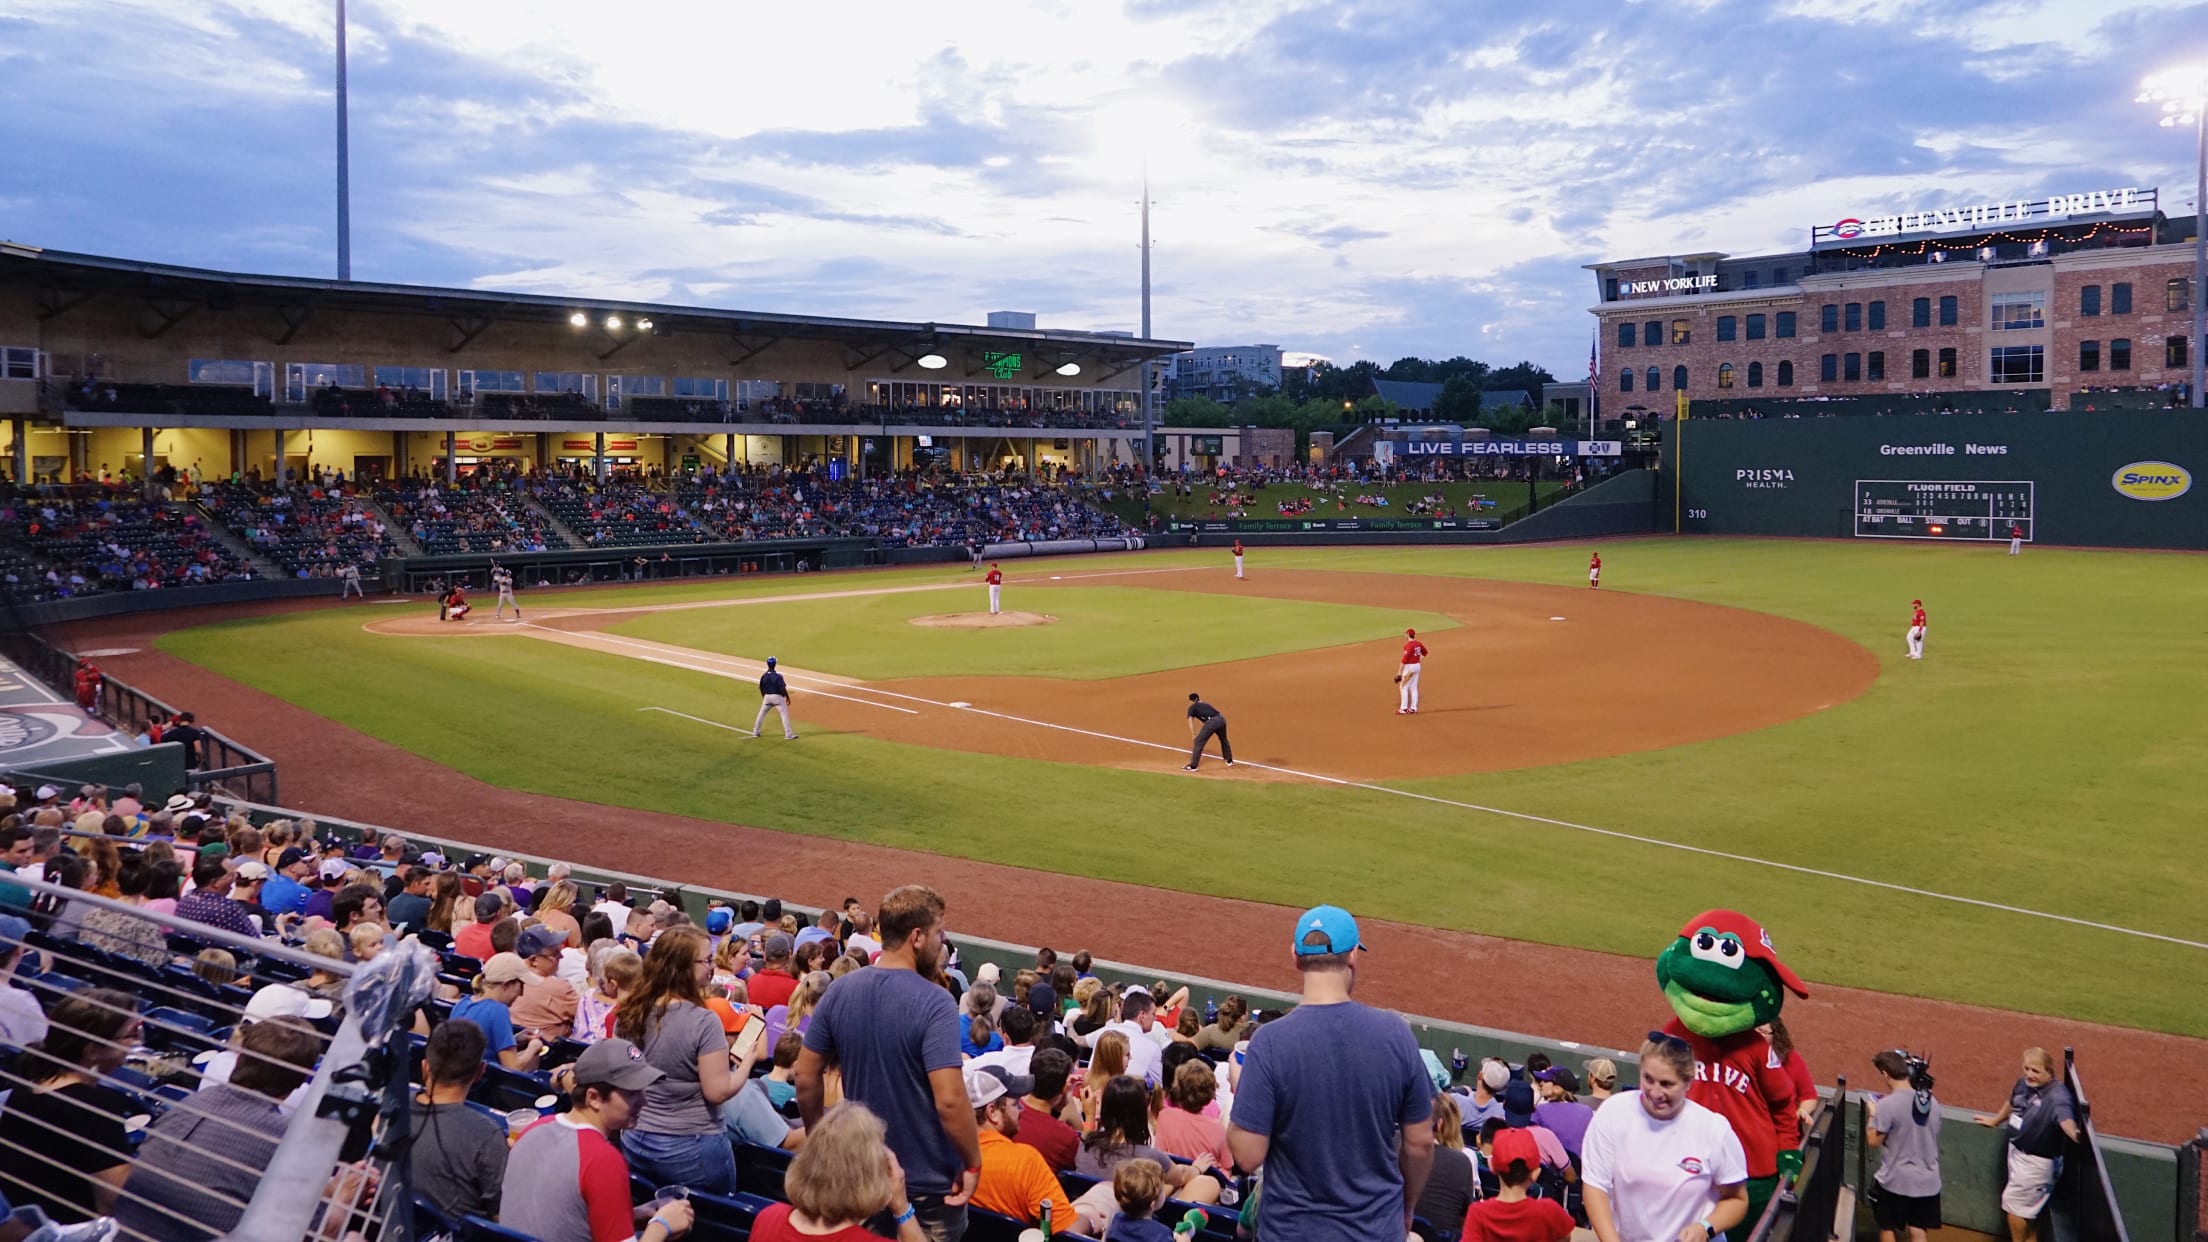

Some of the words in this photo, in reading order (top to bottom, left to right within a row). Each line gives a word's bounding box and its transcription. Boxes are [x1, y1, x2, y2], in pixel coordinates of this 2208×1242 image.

[1864, 200, 2032, 234] GREENVILLE
[2048, 187, 2138, 217] DRIVE
[1631, 281, 1660, 294] NEW
[1663, 277, 1694, 291] YORK
[1693, 274, 1718, 288] LIFE
[1408, 442, 1453, 455] LIVE
[1461, 442, 1563, 455] FEARLESS
[1880, 443, 1955, 455] Greenville
[1965, 443, 2008, 455] News
[1736, 469, 1795, 480] PRISMA
[2120, 472, 2182, 486] SPINX
[1746, 481, 1784, 489] HEALTH
[1688, 509, 1707, 519] 310
[1239, 522, 1263, 531] Family
[1265, 522, 1292, 530] Terrace
[1370, 521, 1395, 530] Family
[1396, 521, 1423, 529] Terrace
[1694, 1060, 1751, 1094] RIVE
